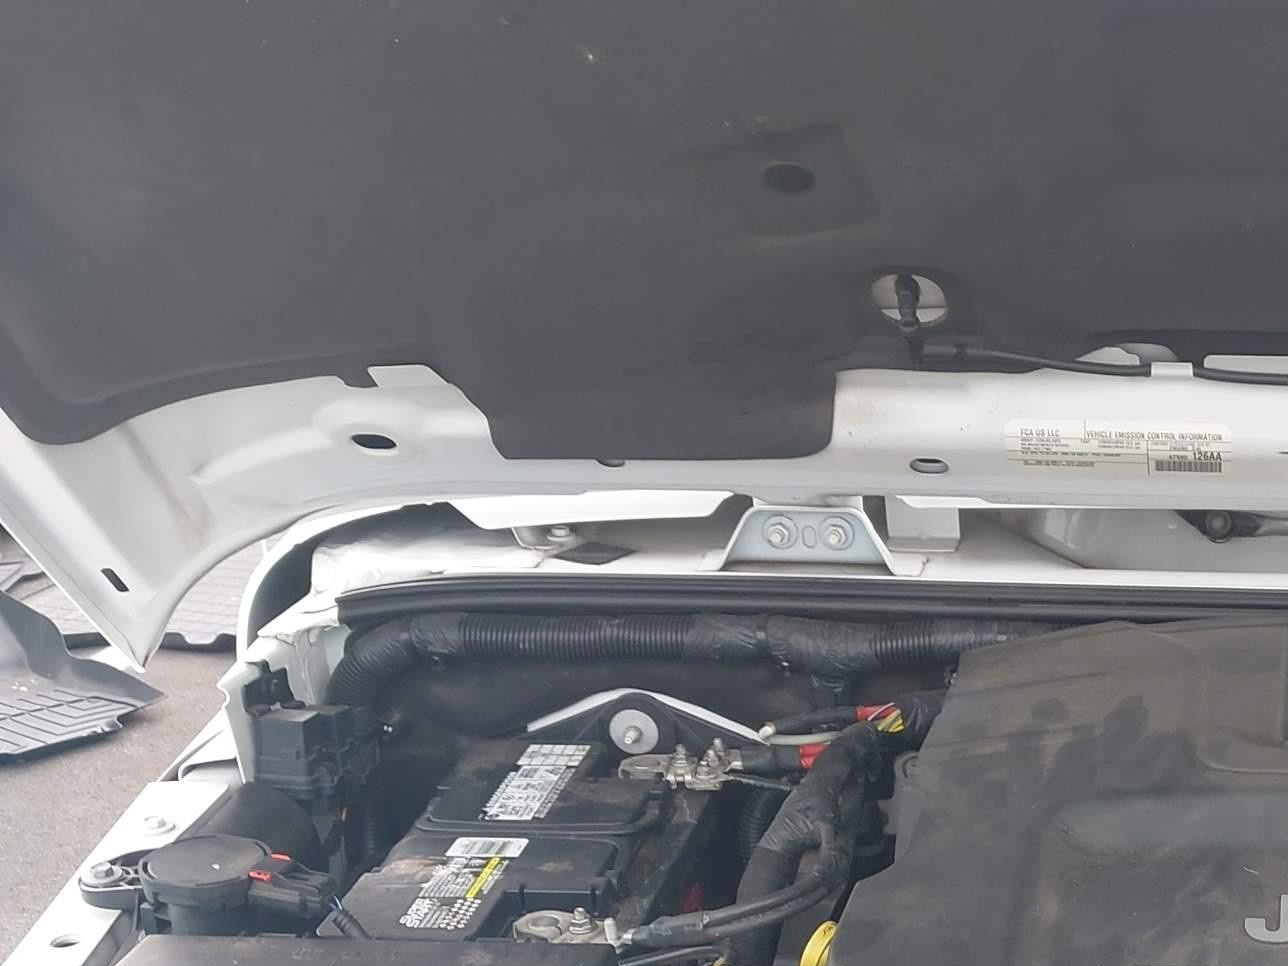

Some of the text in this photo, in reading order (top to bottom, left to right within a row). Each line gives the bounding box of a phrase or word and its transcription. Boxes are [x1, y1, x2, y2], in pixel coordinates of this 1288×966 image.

[1035, 428, 1045, 437] US
[1047, 429, 1060, 437] LLC
[1086, 431, 1222, 440] VEHICLE EMISSION CONTROL INFORMATION
[1193, 451, 1222, 461] 126AA
